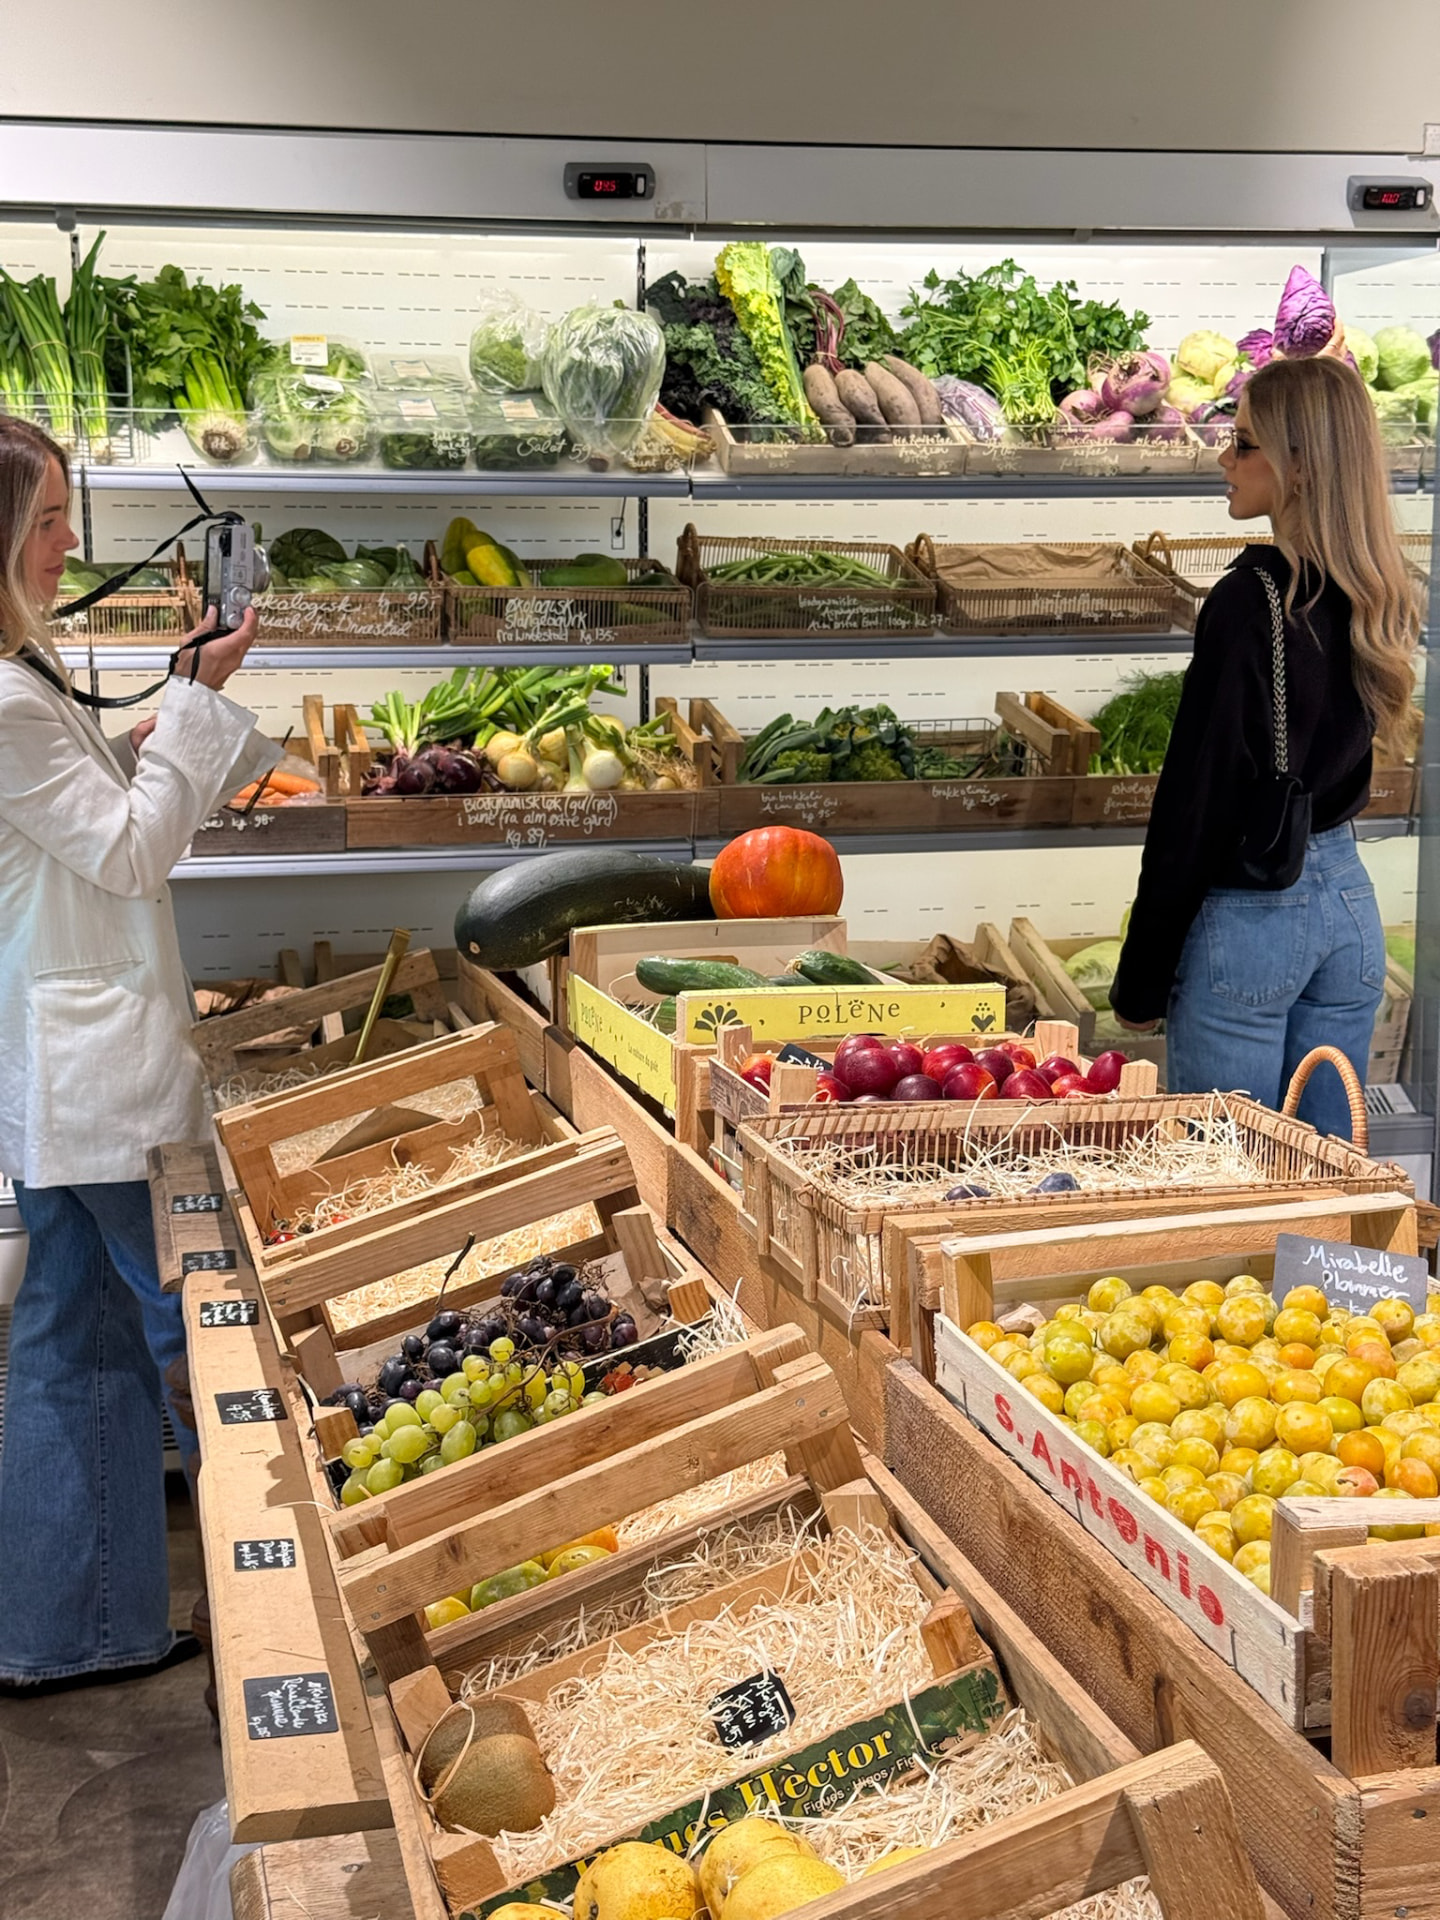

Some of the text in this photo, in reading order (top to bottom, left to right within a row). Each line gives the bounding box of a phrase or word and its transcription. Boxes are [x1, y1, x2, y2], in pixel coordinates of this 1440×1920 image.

[516, 437, 567, 457] Salat
[499, 810, 519, 831] fra
[1302, 1244, 1409, 1283] Mirabelle
[734, 1730, 894, 1812] Hèctor
